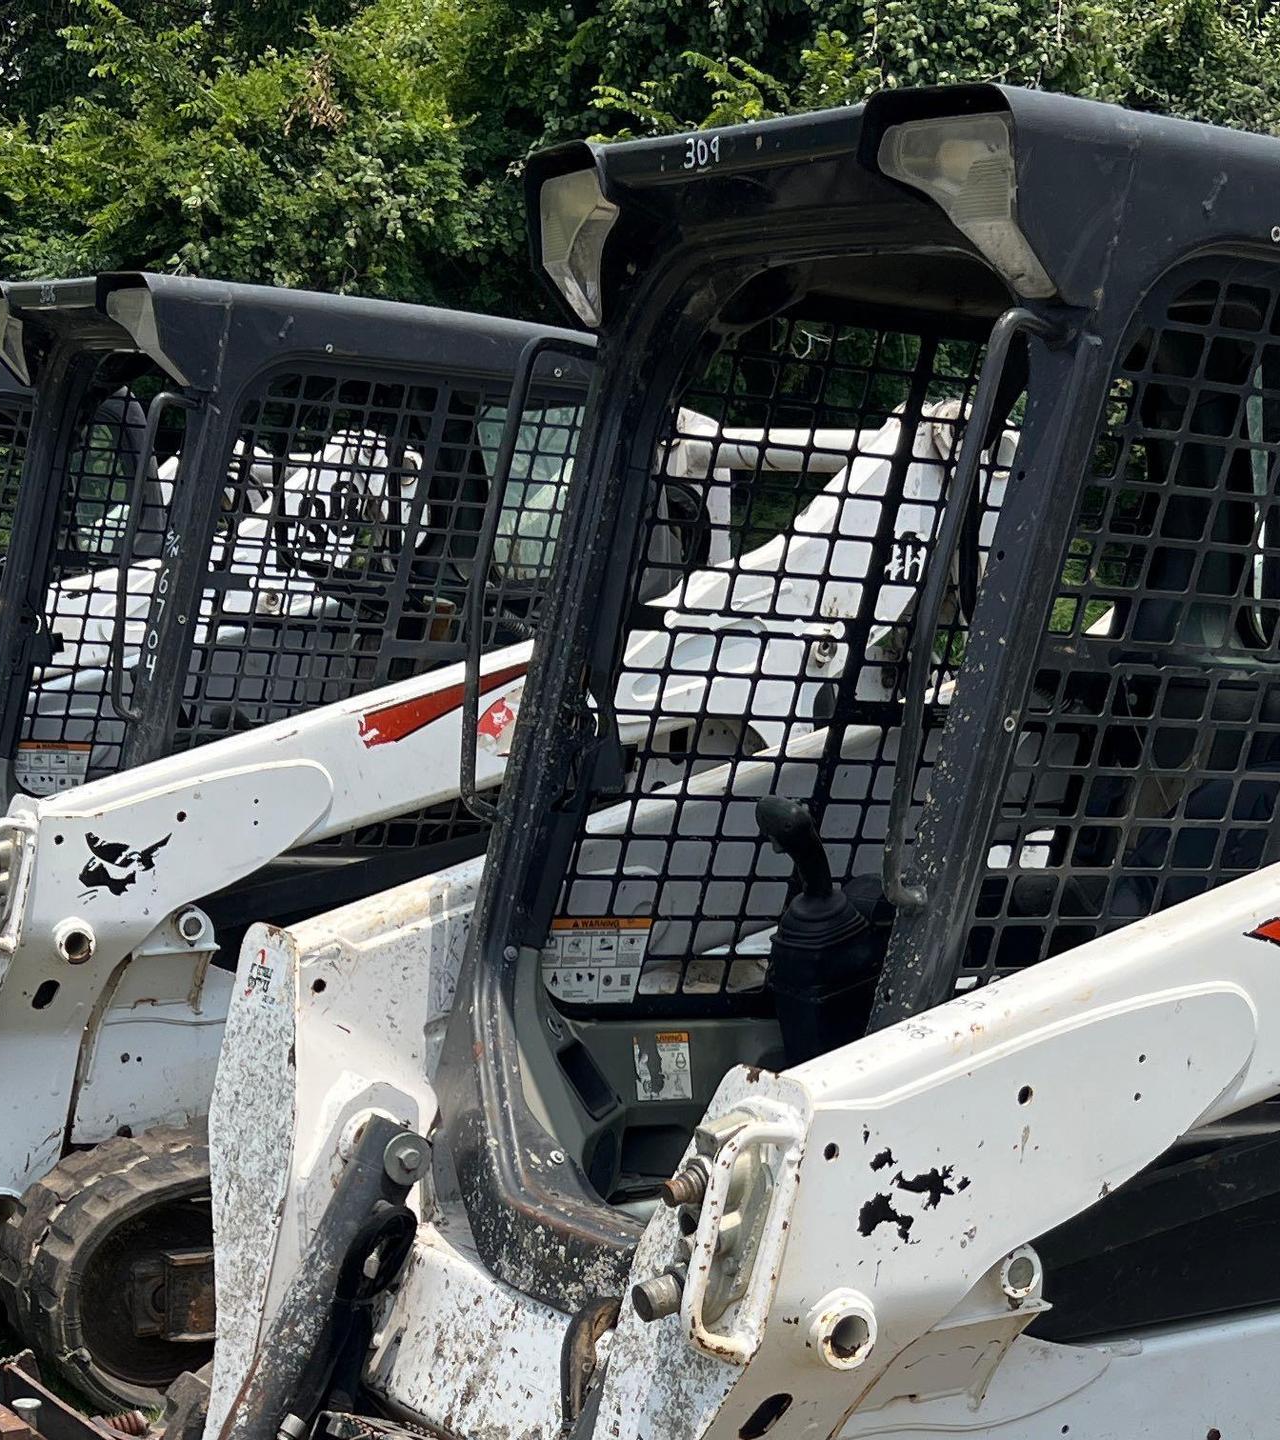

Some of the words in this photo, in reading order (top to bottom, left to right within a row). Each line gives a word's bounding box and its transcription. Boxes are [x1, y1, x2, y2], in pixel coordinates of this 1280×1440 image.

[683, 135, 720, 169] 309
[165, 530, 181, 558] S/N
[145, 568, 170, 681] 6704
[581, 919, 620, 928] WARNING
